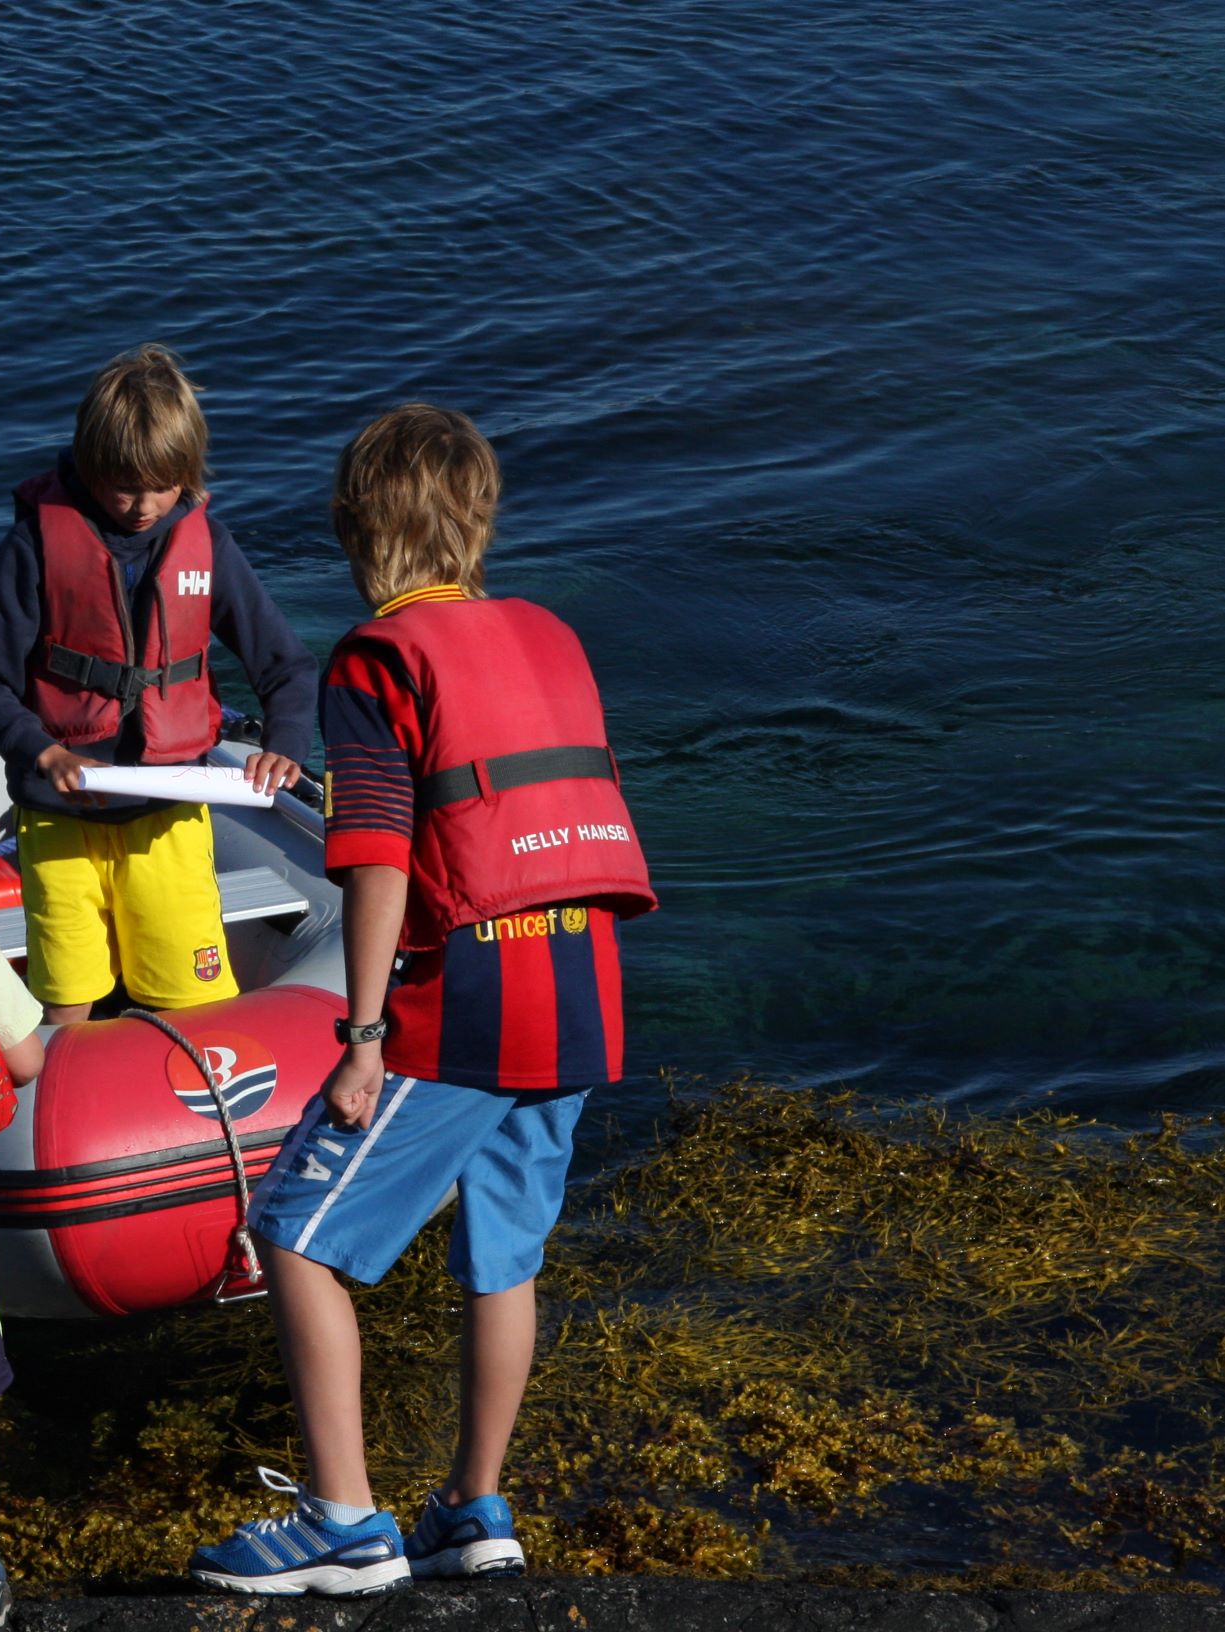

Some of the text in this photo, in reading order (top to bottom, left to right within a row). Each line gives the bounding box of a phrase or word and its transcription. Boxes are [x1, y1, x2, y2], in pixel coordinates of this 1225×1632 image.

[178, 570, 211, 596] HH
[511, 824, 630, 855] HELLY HANSEN
[474, 907, 558, 942] unicef
